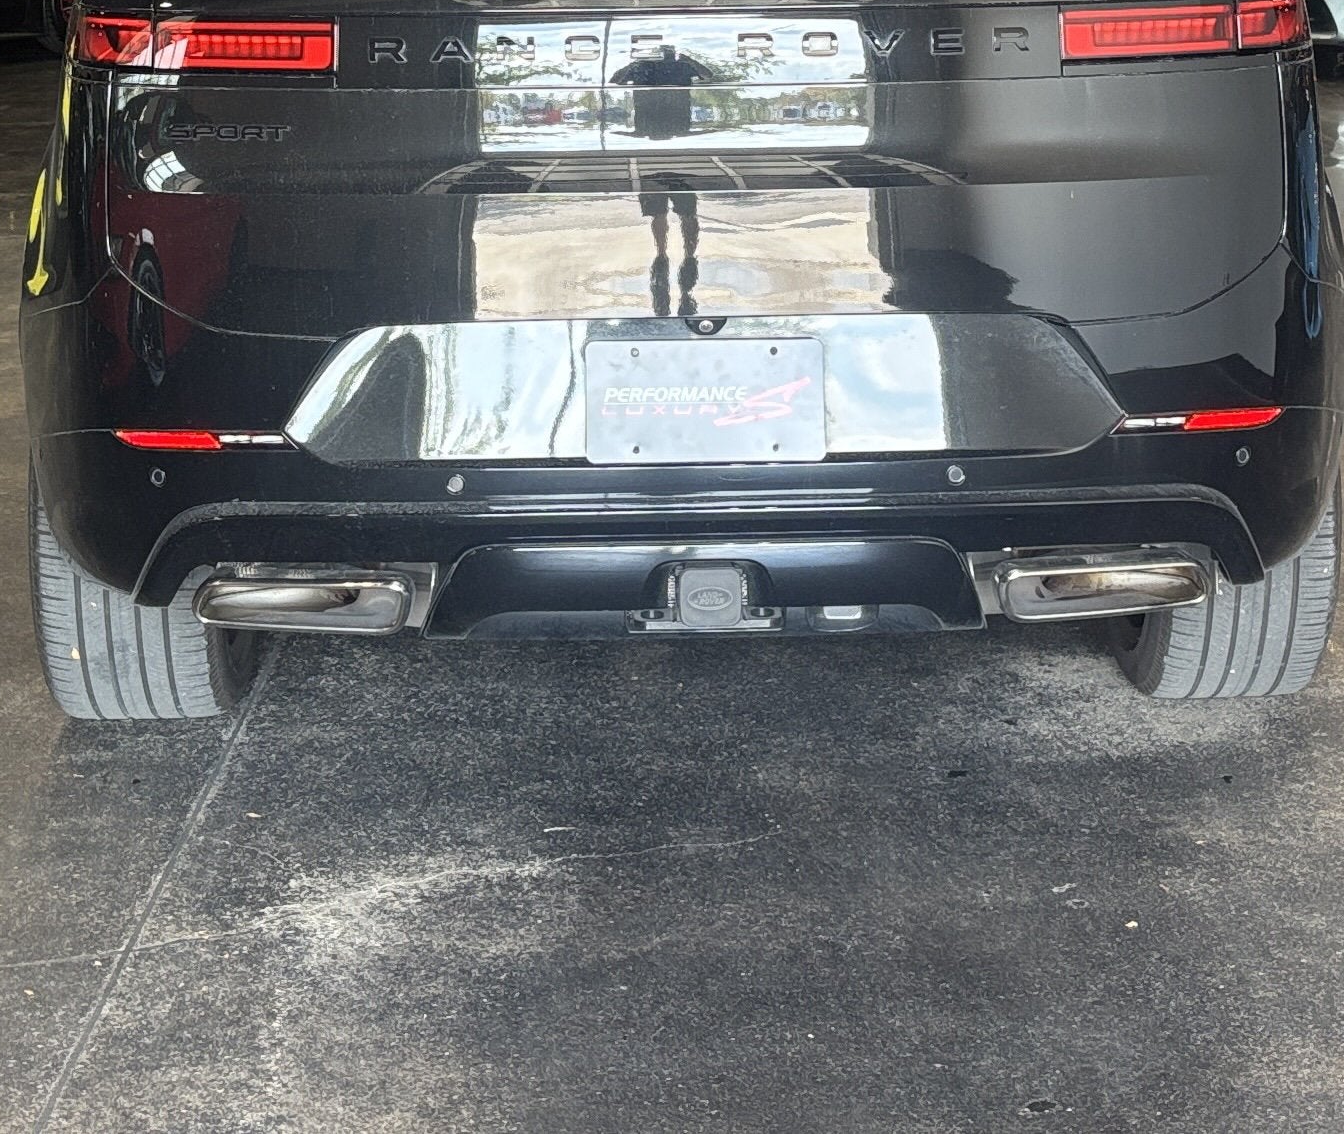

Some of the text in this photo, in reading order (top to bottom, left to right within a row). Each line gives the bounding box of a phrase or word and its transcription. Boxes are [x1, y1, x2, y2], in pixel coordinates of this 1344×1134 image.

[367, 27, 1030, 64] RANGE ROVER
[165, 124, 291, 142] SPORT
[603, 385, 749, 404] PERFORMANCE
[601, 404, 743, 416] LUXURY
